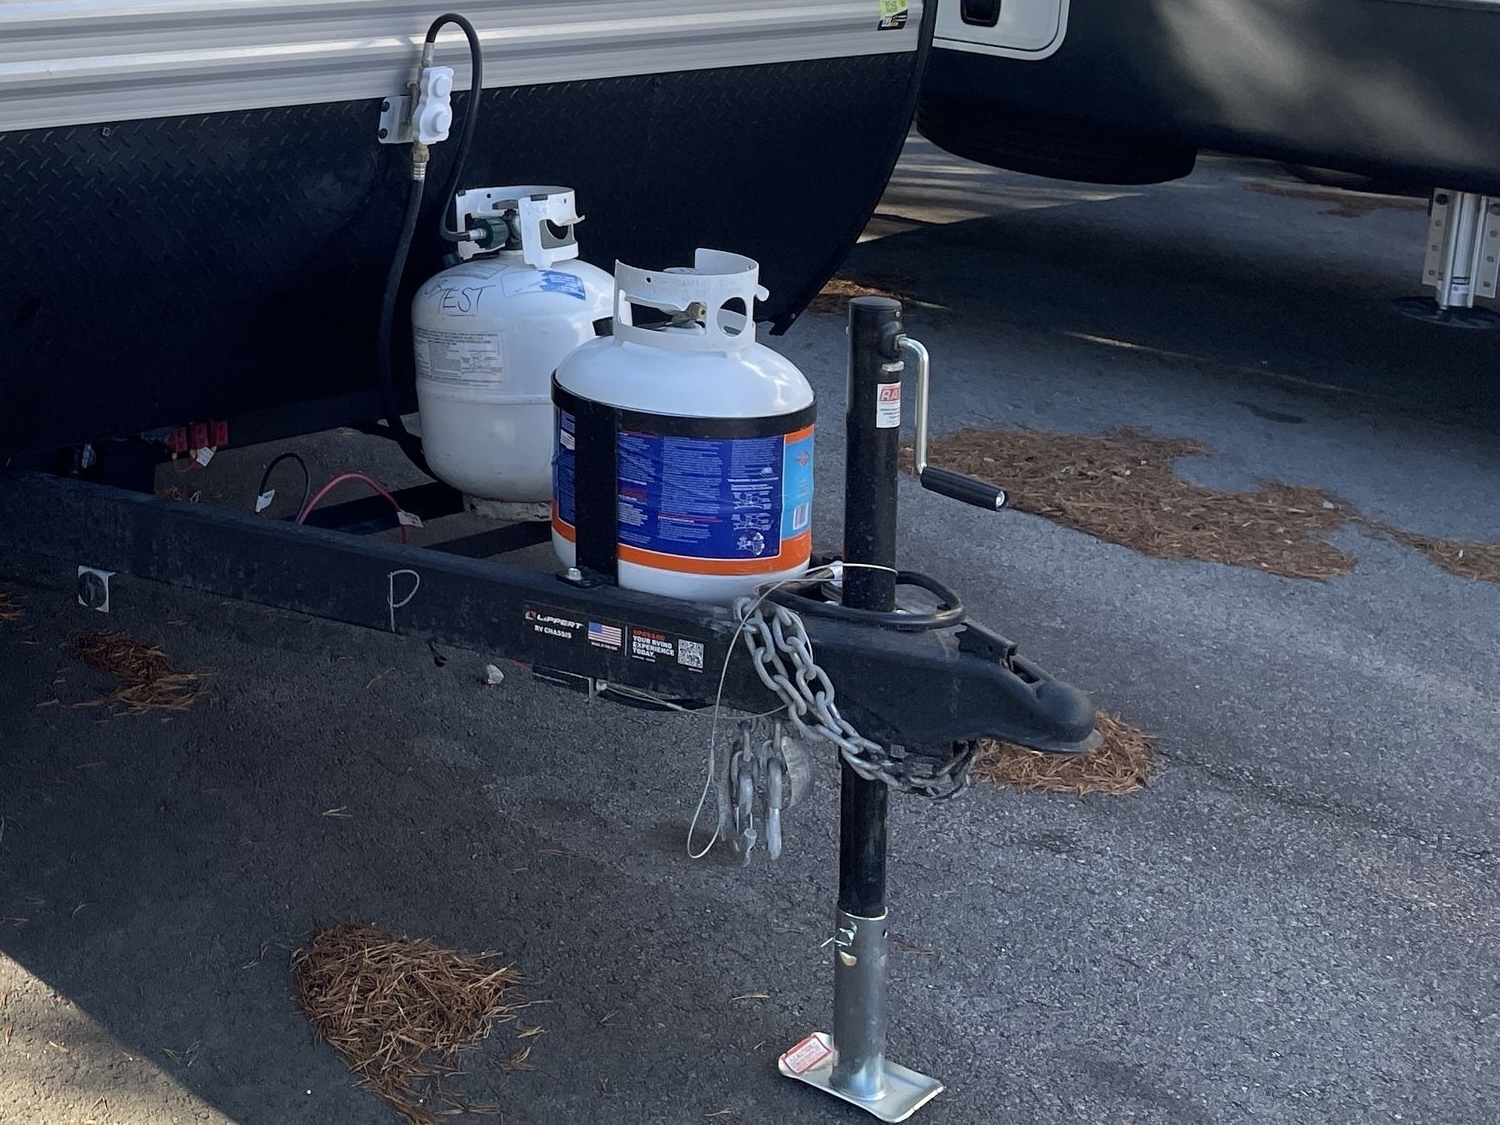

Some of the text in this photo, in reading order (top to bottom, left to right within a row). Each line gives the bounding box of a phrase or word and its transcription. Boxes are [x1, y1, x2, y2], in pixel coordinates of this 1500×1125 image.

[387, 569, 420, 632] P
[537, 614, 584, 629] LIPPERT
[534, 624, 572, 639] RV CHASSIS
[633, 635, 651, 645] YOUR
[651, 638, 673, 650] RVING
[633, 641, 675, 656] EXPERIENCE
